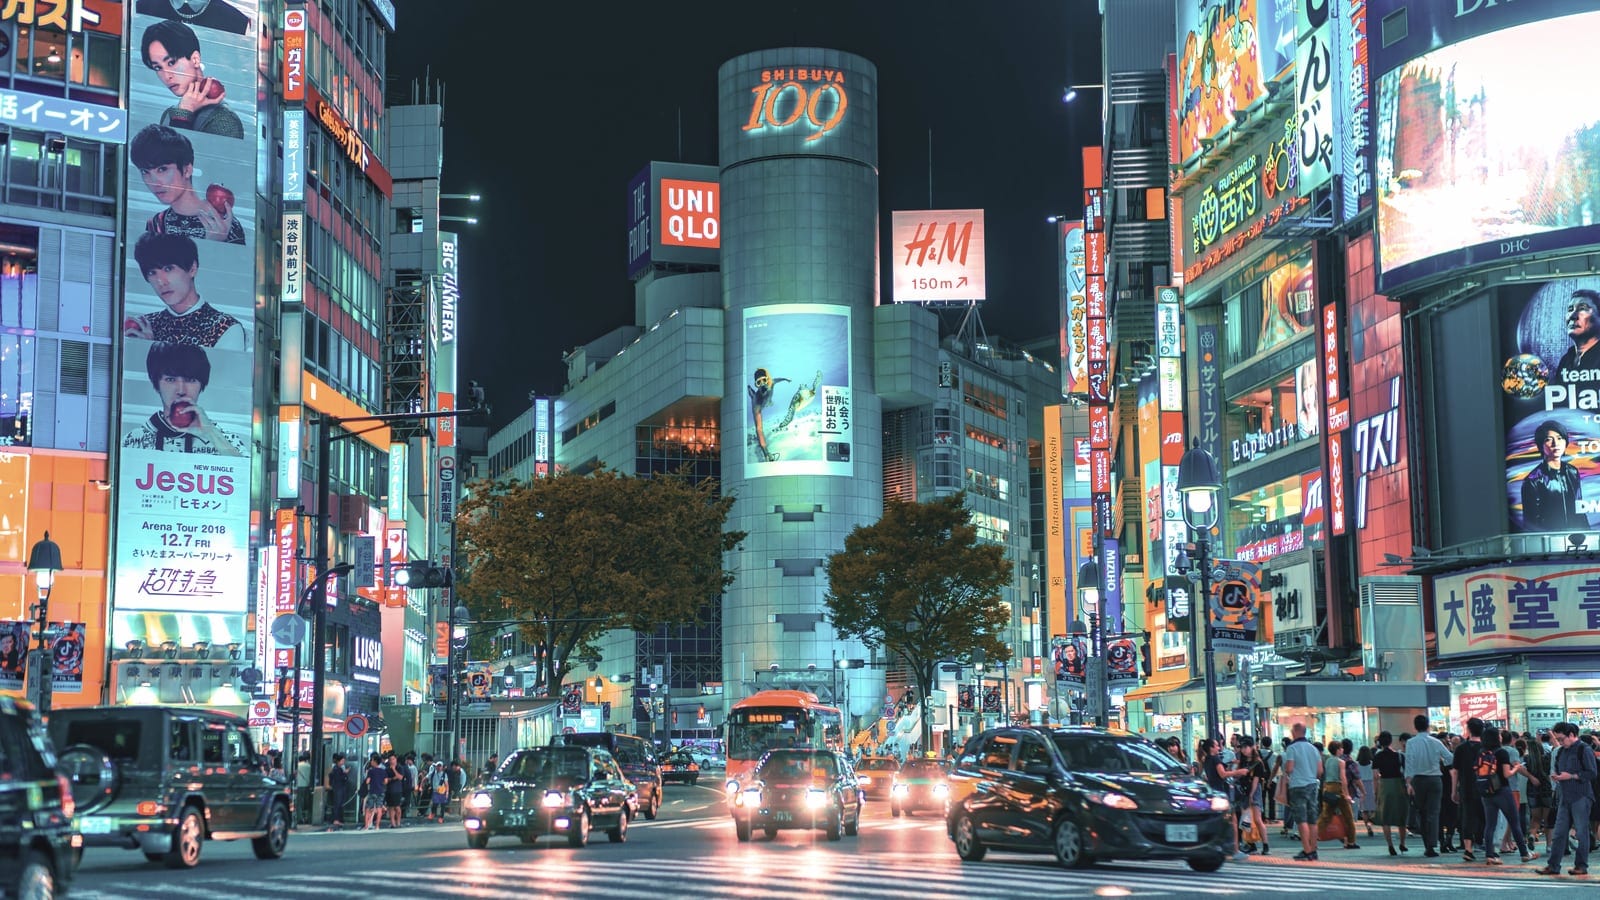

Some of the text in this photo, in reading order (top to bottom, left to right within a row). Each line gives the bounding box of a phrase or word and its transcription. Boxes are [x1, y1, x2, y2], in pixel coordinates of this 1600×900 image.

[287, 48, 302, 91] ガスト
[761, 69, 845, 84] SHIBUYA
[741, 81, 849, 142] 109
[287, 119, 299, 193] 英会話イーオン
[633, 181, 646, 223] THE
[668, 187, 714, 214] UNI
[1220, 172, 1257, 235] 西村
[628, 216, 650, 265] PRIME
[668, 214, 718, 242] QLO
[905, 220, 974, 267] H&M
[1500, 238, 1530, 254] DHC
[286, 218, 298, 295] 渋谷駅前ビル
[442, 241, 454, 269] BIC
[826, 395, 849, 405] 世界に
[1545, 385, 1600, 411] Pla
[1232, 420, 1295, 462] Euphoria
[135, 463, 235, 496] Jesus
[1051, 476, 1060, 537] Matsumoto
[142, 521, 226, 534] Arena Tour 2018
[160, 533, 211, 548] 12.7 FRI
[132, 548, 233, 562] さいたまスーパーアリーナ
[1106, 549, 1116, 592] MIZUHO
[355, 636, 382, 672] LUSH
